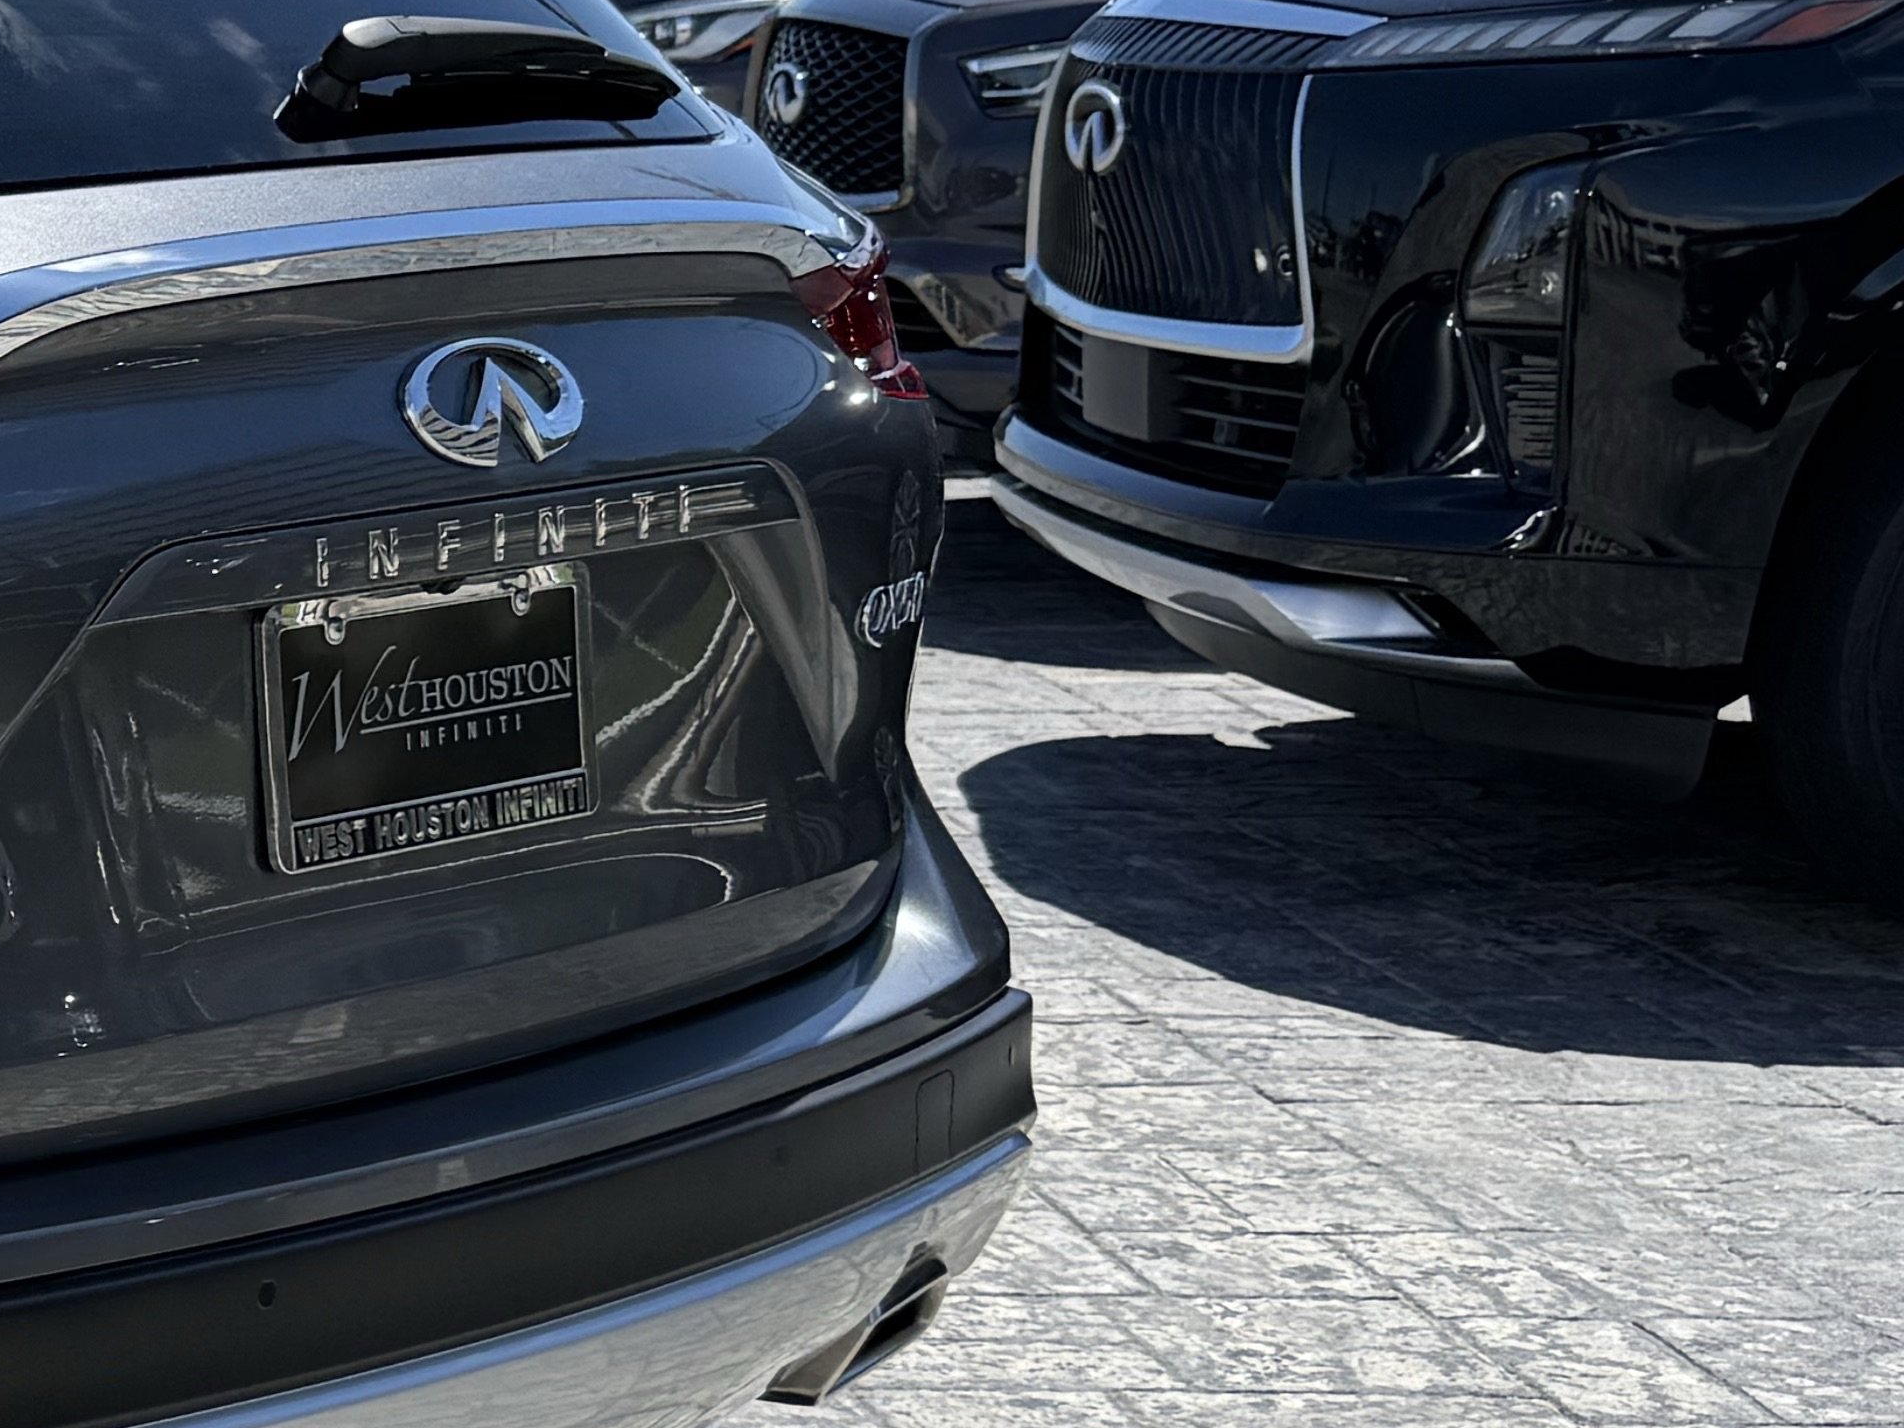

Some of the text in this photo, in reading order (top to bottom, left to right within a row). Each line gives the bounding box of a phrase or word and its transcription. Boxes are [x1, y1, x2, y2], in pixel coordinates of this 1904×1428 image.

[315, 484, 692, 588] INFINITI
[405, 713, 523, 751] INFINITI
[297, 777, 586, 863] WEST HOUSTON INFINITI
